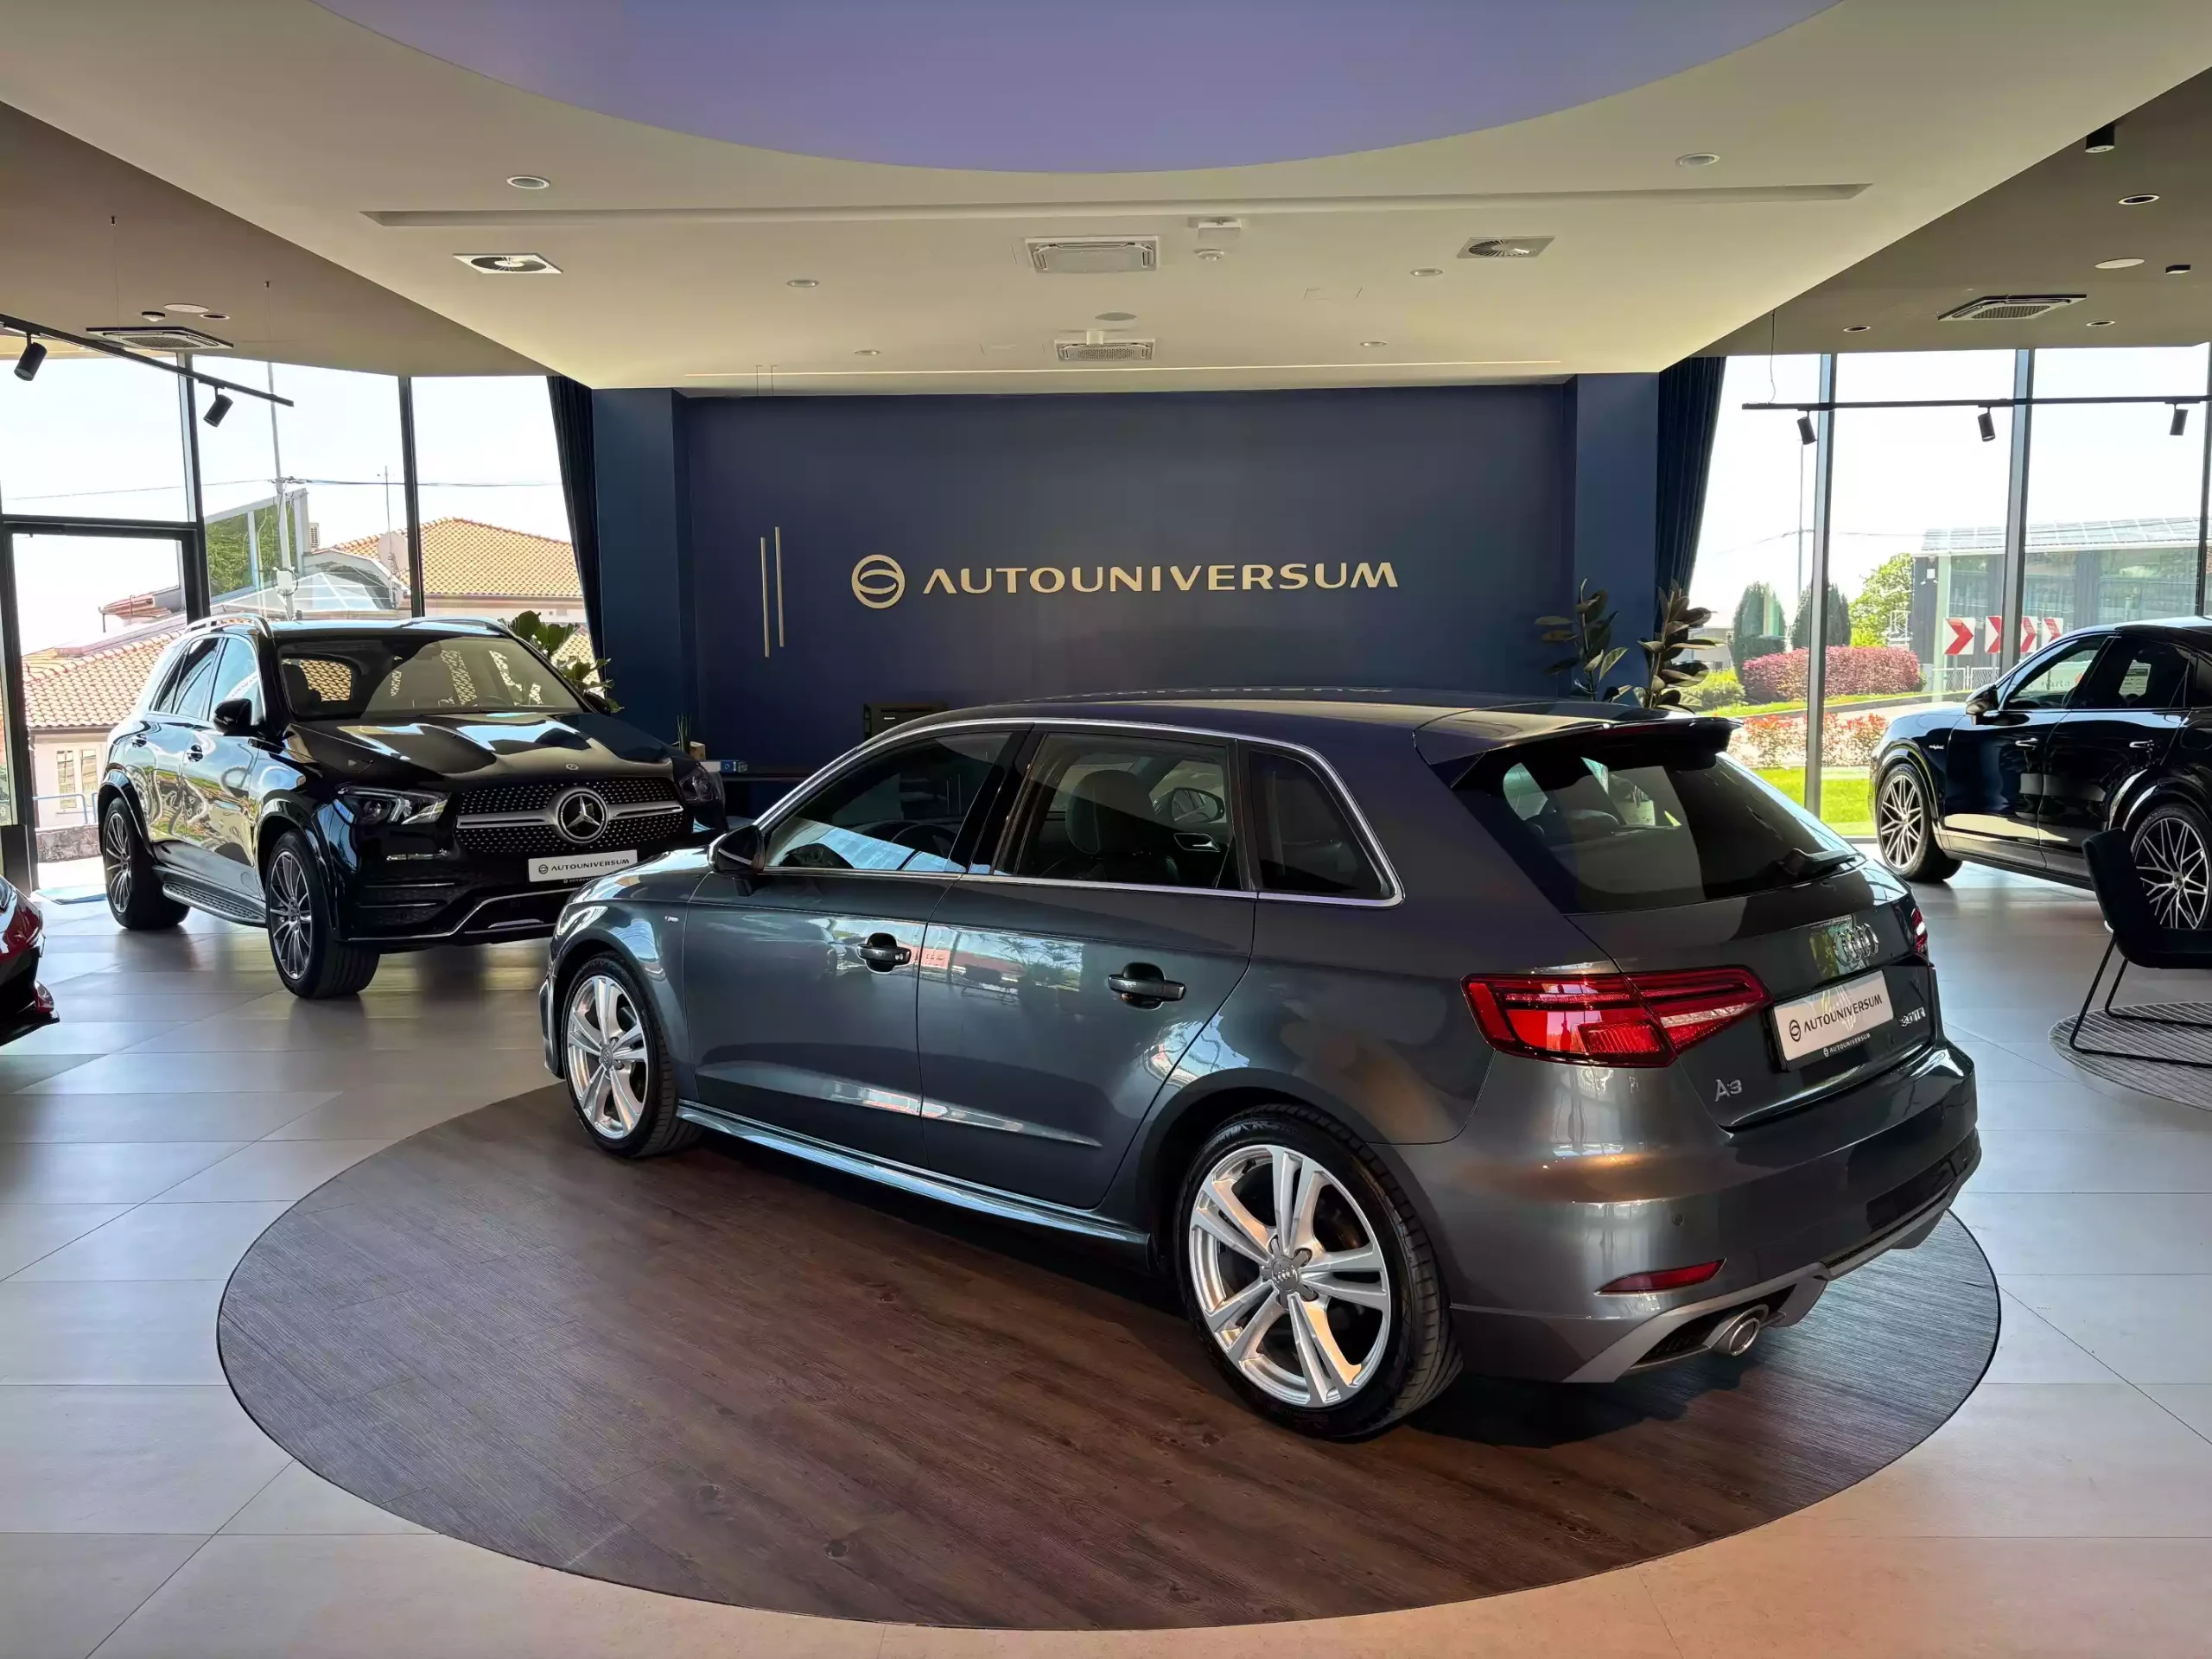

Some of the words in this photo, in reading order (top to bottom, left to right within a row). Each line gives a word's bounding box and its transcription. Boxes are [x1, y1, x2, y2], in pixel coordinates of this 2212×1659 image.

[922, 562, 1399, 594] AUTOUNIVERSUM
[551, 858, 630, 872] AUTOUNIVERSUM
[1804, 994, 1883, 1033] AUTOUNIVERSUM
[1829, 1033, 1872, 1054] AUTOUNIVERSUM
[1714, 1078, 1743, 1102] A3
